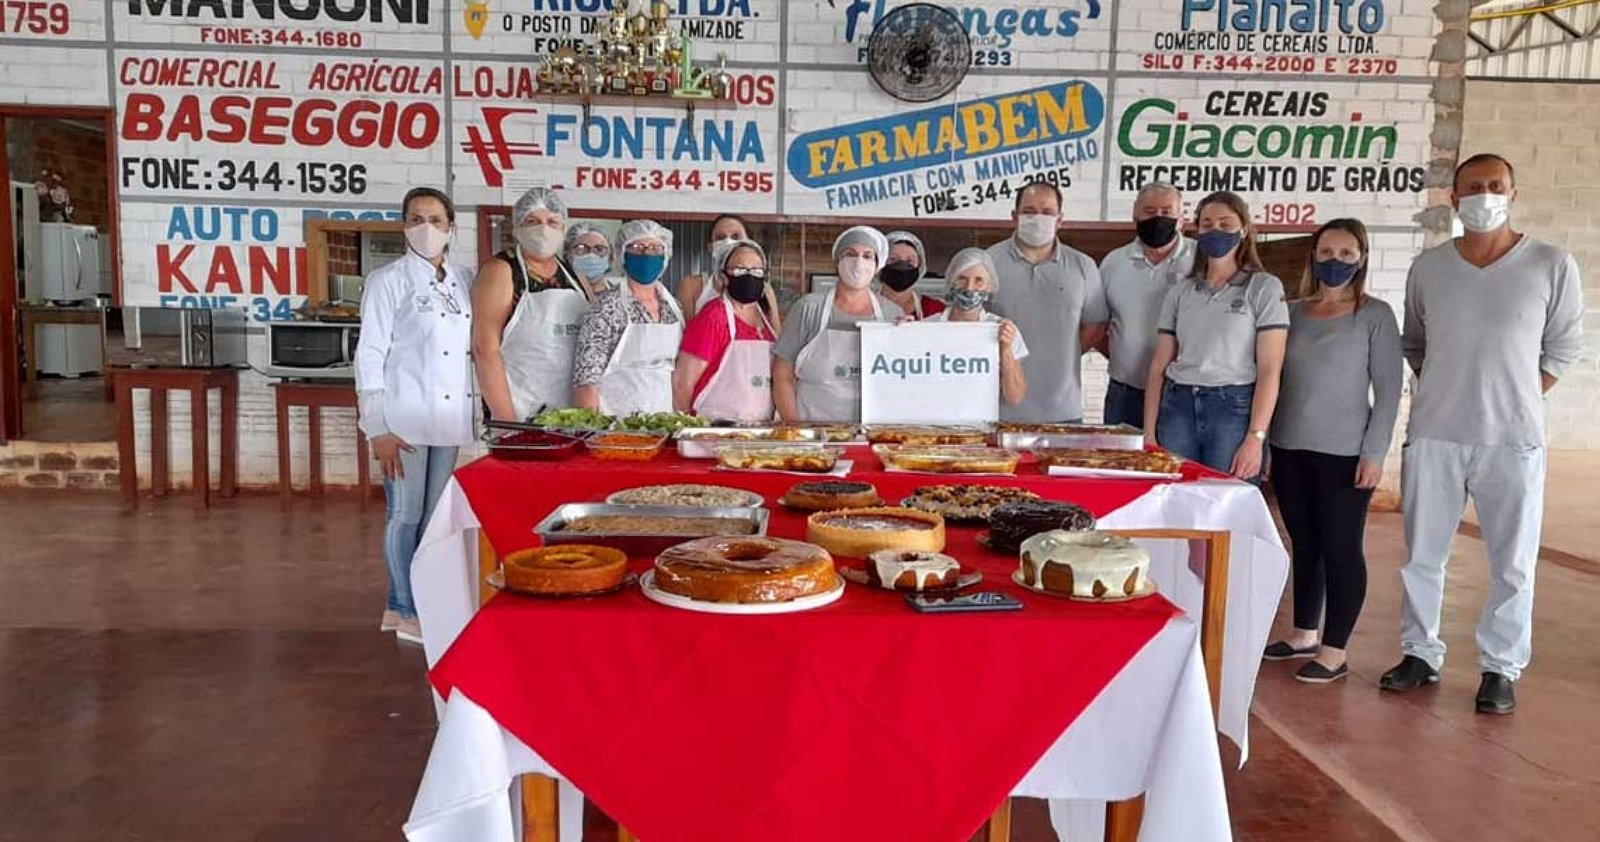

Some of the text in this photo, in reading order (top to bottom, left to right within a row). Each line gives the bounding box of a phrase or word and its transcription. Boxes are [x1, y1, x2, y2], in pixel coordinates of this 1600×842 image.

[200, 27, 362, 48] FONE:344-1680
[503, 15, 512, 31] O
[522, 15, 571, 34] POSTO
[679, 19, 745, 40] AMIZADE
[1154, 30, 1379, 54] COMÉRCIO DE CEREAIS LTDA.
[120, 57, 442, 95] COMERCIAL AGRÍCOLA
[1143, 54, 1184, 70] SILO
[1324, 58, 1337, 73] E
[1350, 59, 1398, 75] 2370
[1205, 91, 1329, 117] CEREAIS
[121, 93, 440, 150] BASEGGIO
[806, 82, 1091, 179] FARMABEM
[1117, 97, 1398, 159] Giacomin
[546, 113, 765, 164] FONTANA
[122, 157, 367, 195] FONE:344-1536
[576, 167, 774, 193] FONE:344-1595
[926, 163, 966, 190] COM
[1119, 165, 1297, 193] RECEBIMENTO
[1306, 166, 1337, 193] DE
[166, 206, 279, 242] AUTO
[871, 351, 990, 380] Aqui tem
